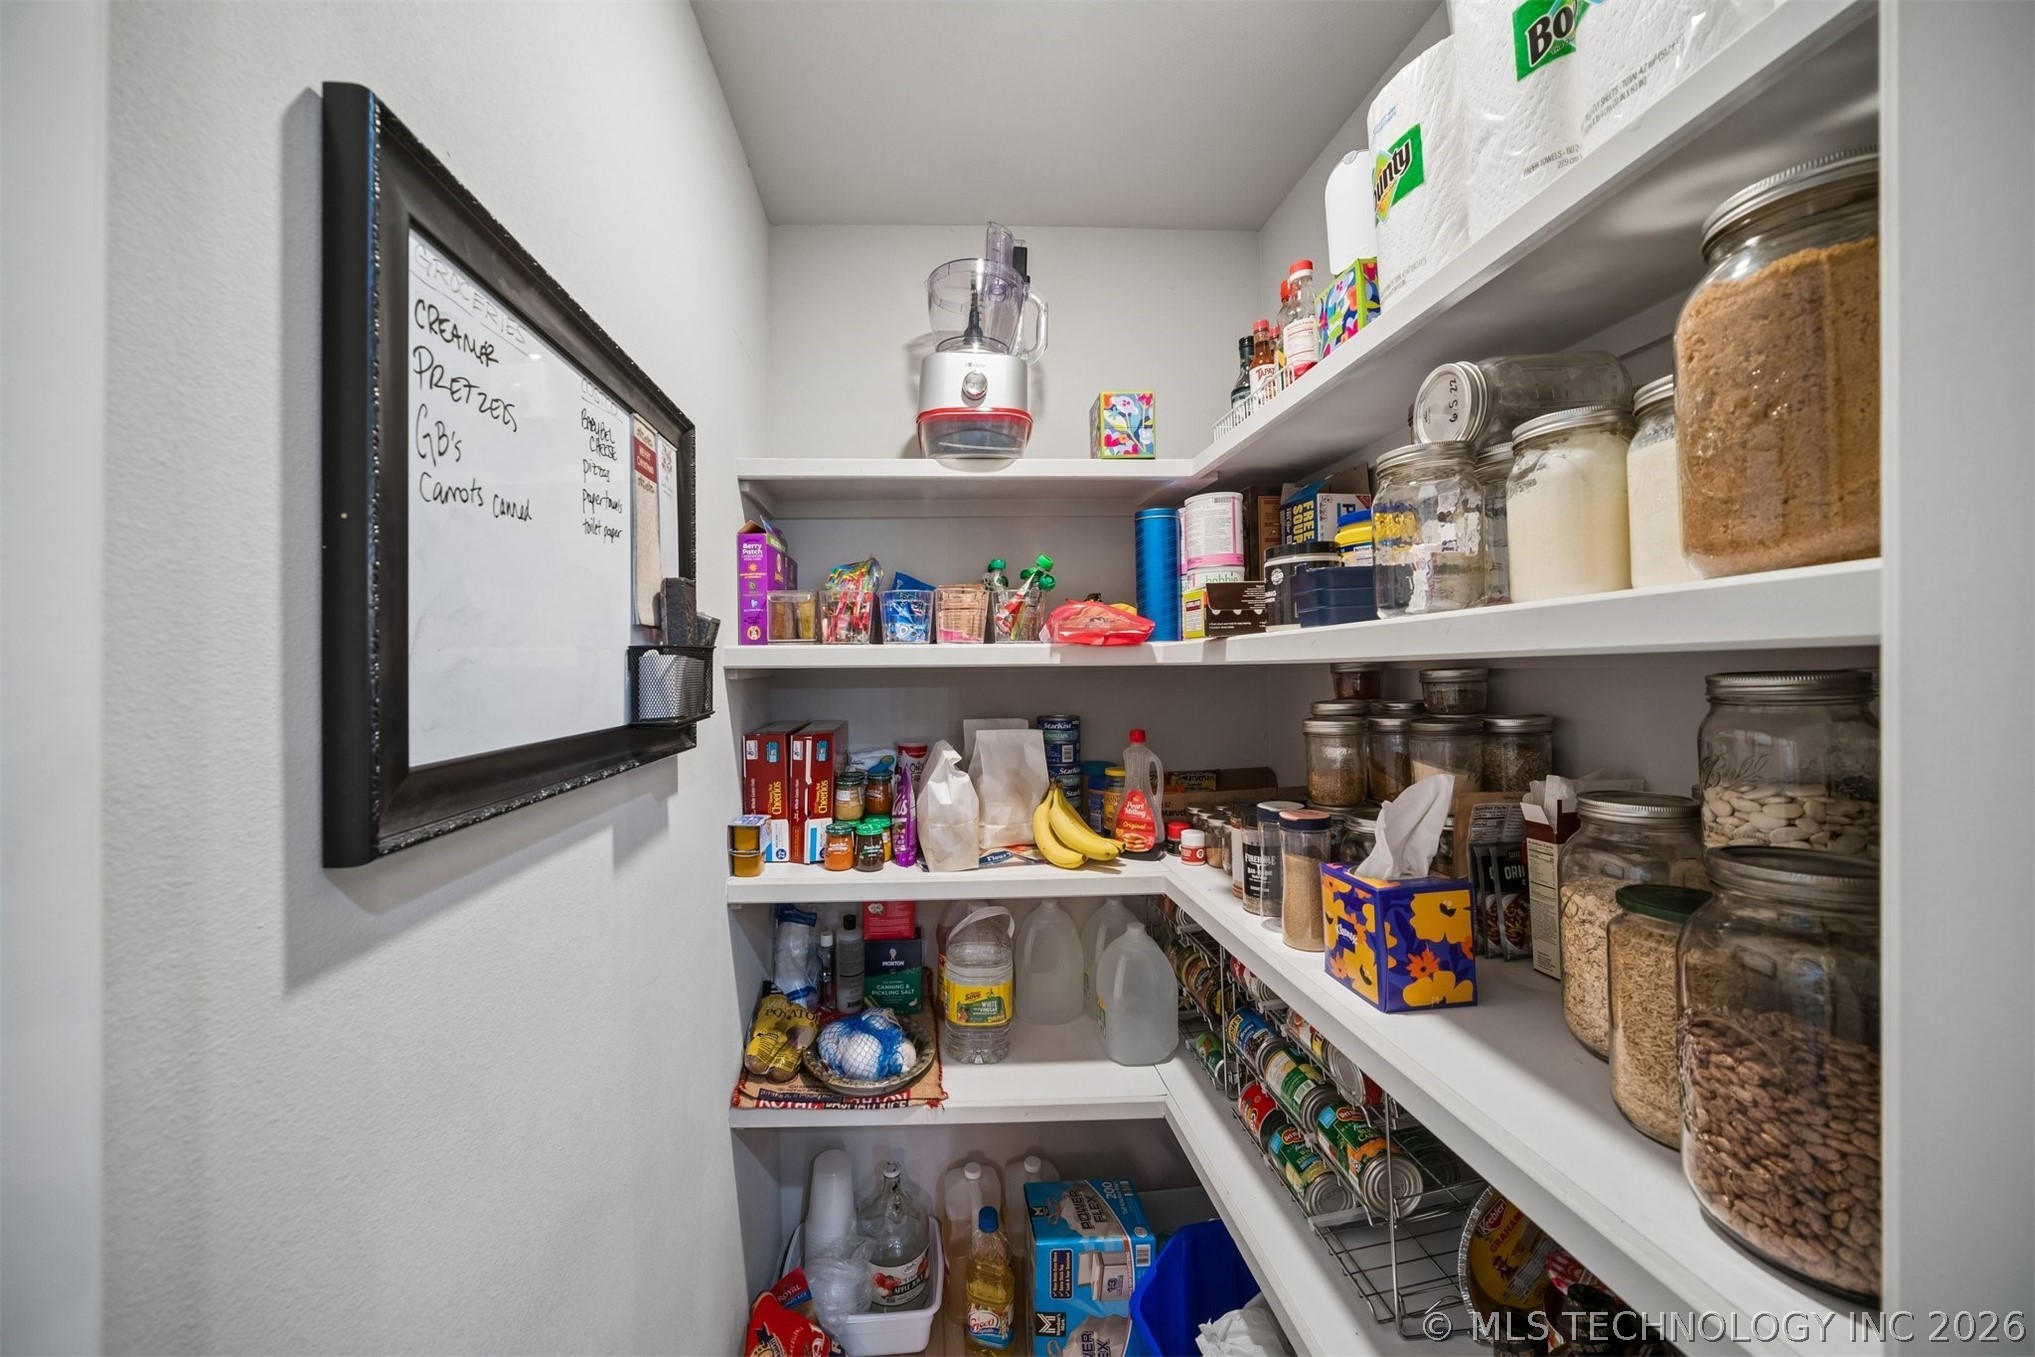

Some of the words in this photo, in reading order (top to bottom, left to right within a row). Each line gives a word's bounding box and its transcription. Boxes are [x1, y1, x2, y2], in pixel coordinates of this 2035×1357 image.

[419, 472, 484, 507] Carrots
[1293, 504, 1304, 544] SOUP
[1303, 500, 1314, 542] FREE
[743, 543, 762, 551] Berry
[772, 781, 782, 815] Cheerios
[819, 780, 828, 814] Cheerios
[1126, 801, 1144, 811] Pearl
[1123, 821, 1147, 831] Original
[1124, 808, 1147, 818] Milling
[1102, 1181, 1118, 1200] 200
[1069, 1190, 1095, 1230] POWER
[1087, 1195, 1108, 1223] FLEX
[1479, 1200, 1506, 1235] Keebler
[777, 1284, 802, 1302] ROYAL
